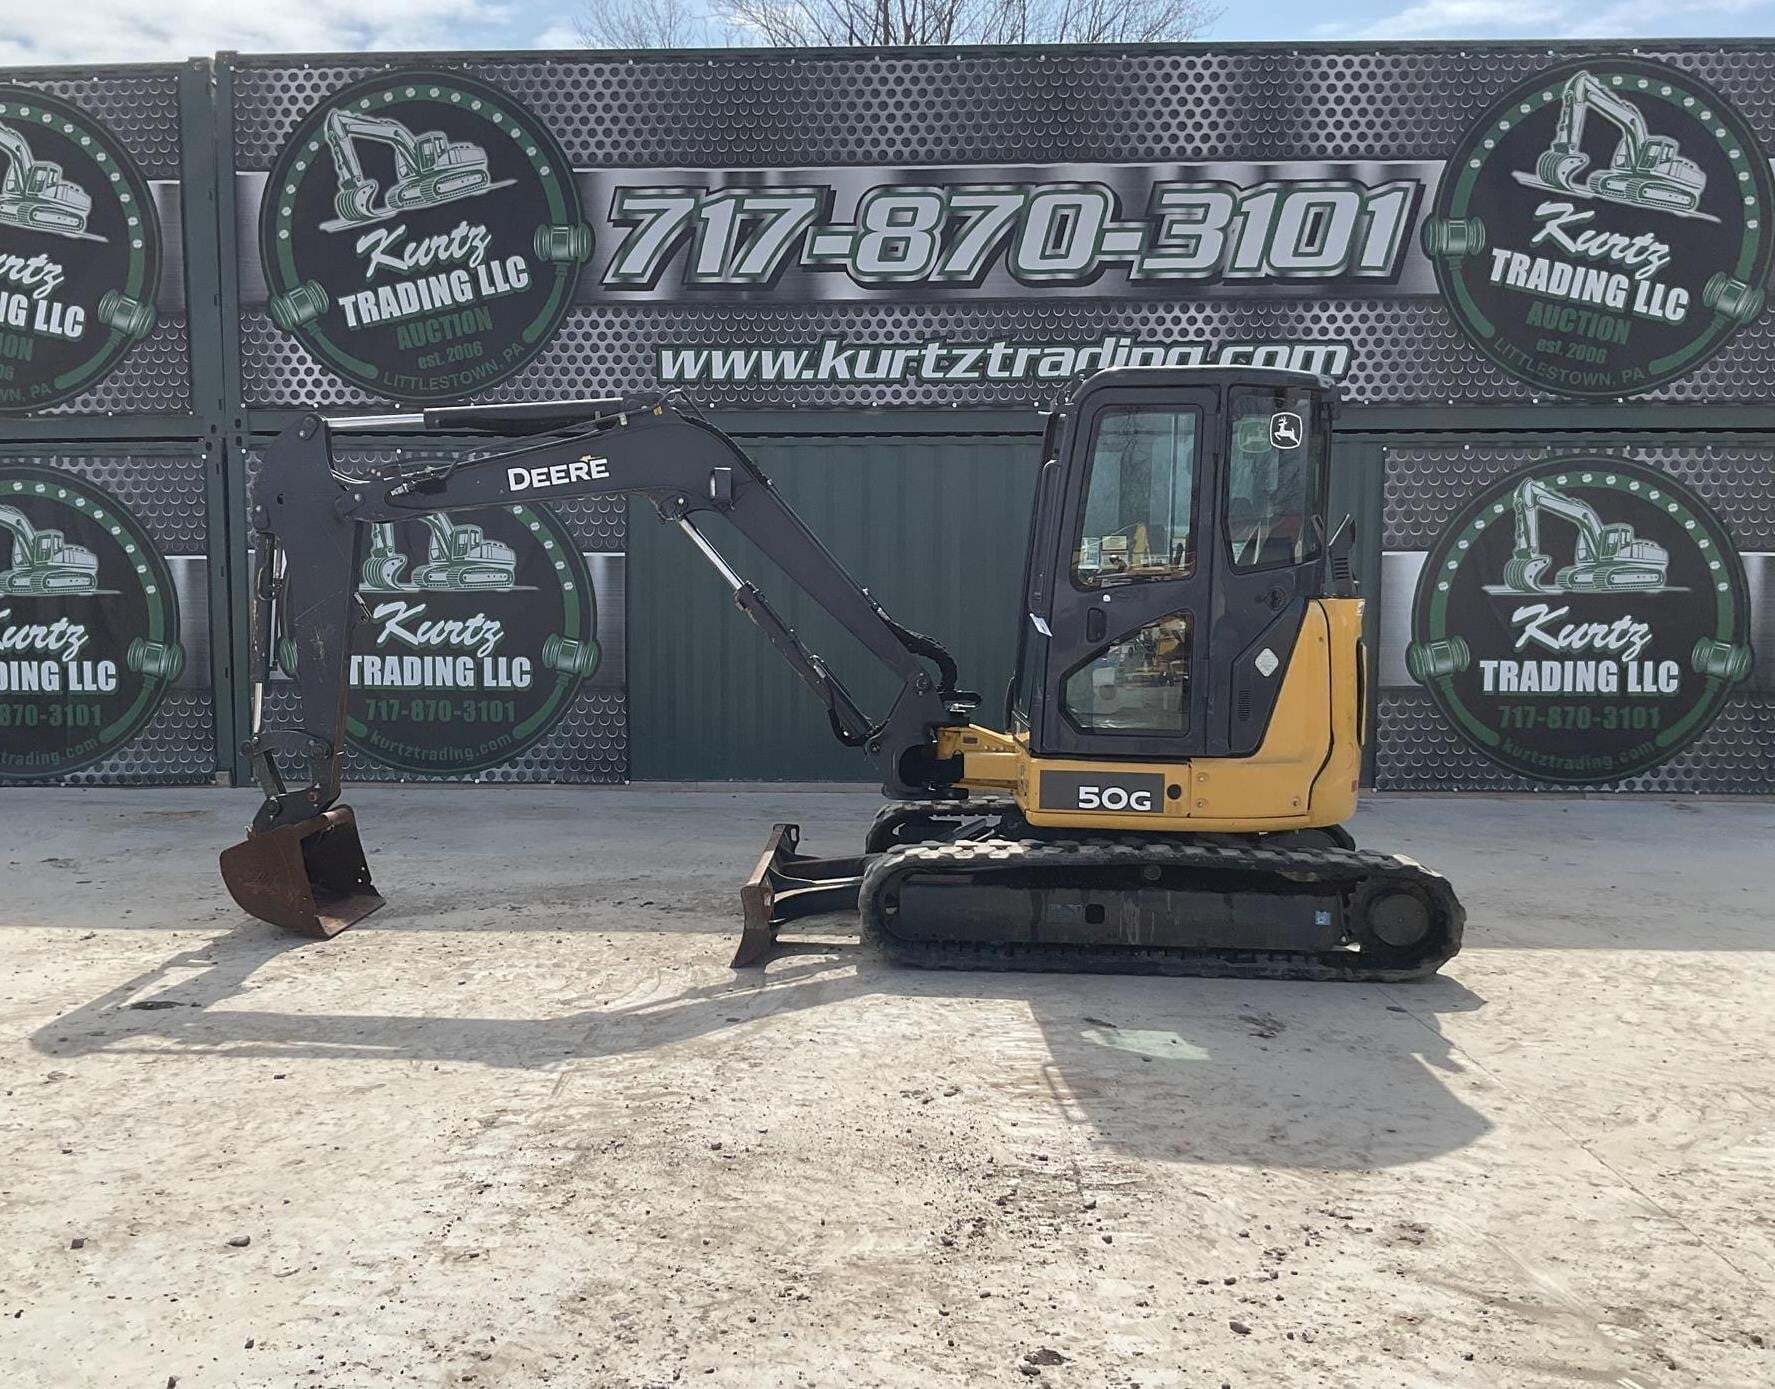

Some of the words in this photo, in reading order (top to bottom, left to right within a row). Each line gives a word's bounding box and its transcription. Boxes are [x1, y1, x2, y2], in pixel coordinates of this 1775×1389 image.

[356, 221, 492, 277] Kurtz
[604, 184, 1418, 285] 717-870-3101
[1532, 201, 1670, 279] Kurtz
[338, 268, 474, 328] TRADING
[477, 255, 529, 296] LLC
[1490, 248, 1629, 309] TRADING
[1634, 280, 1689, 321] LLC
[34, 299, 86, 337] LLC
[397, 306, 493, 350] AUCTION
[1526, 301, 1632, 345] AUCTION
[446, 341, 484, 362] 2006
[503, 343, 525, 362] PA
[658, 337, 1350, 381] www.kurtztradincom
[1566, 342, 1607, 364] 2006
[1622, 367, 1645, 383] PA
[507, 459, 610, 491] DEERE
[372, 601, 504, 657] Kurtz
[1512, 603, 1653, 661] Kurtz
[68, 660, 117, 692] LLC
[483, 656, 531, 688] LLC
[1480, 660, 1618, 693] TRADING
[1627, 660, 1679, 693] LLC
[366, 699, 515, 722] 717-870-3101
[1497, 705, 1659, 729] 717-870-3101
[369, 730, 512, 761] kurtztrading.com
[1503, 738, 1655, 770] kurtztrading.com
[1078, 786, 1152, 811] 50G
